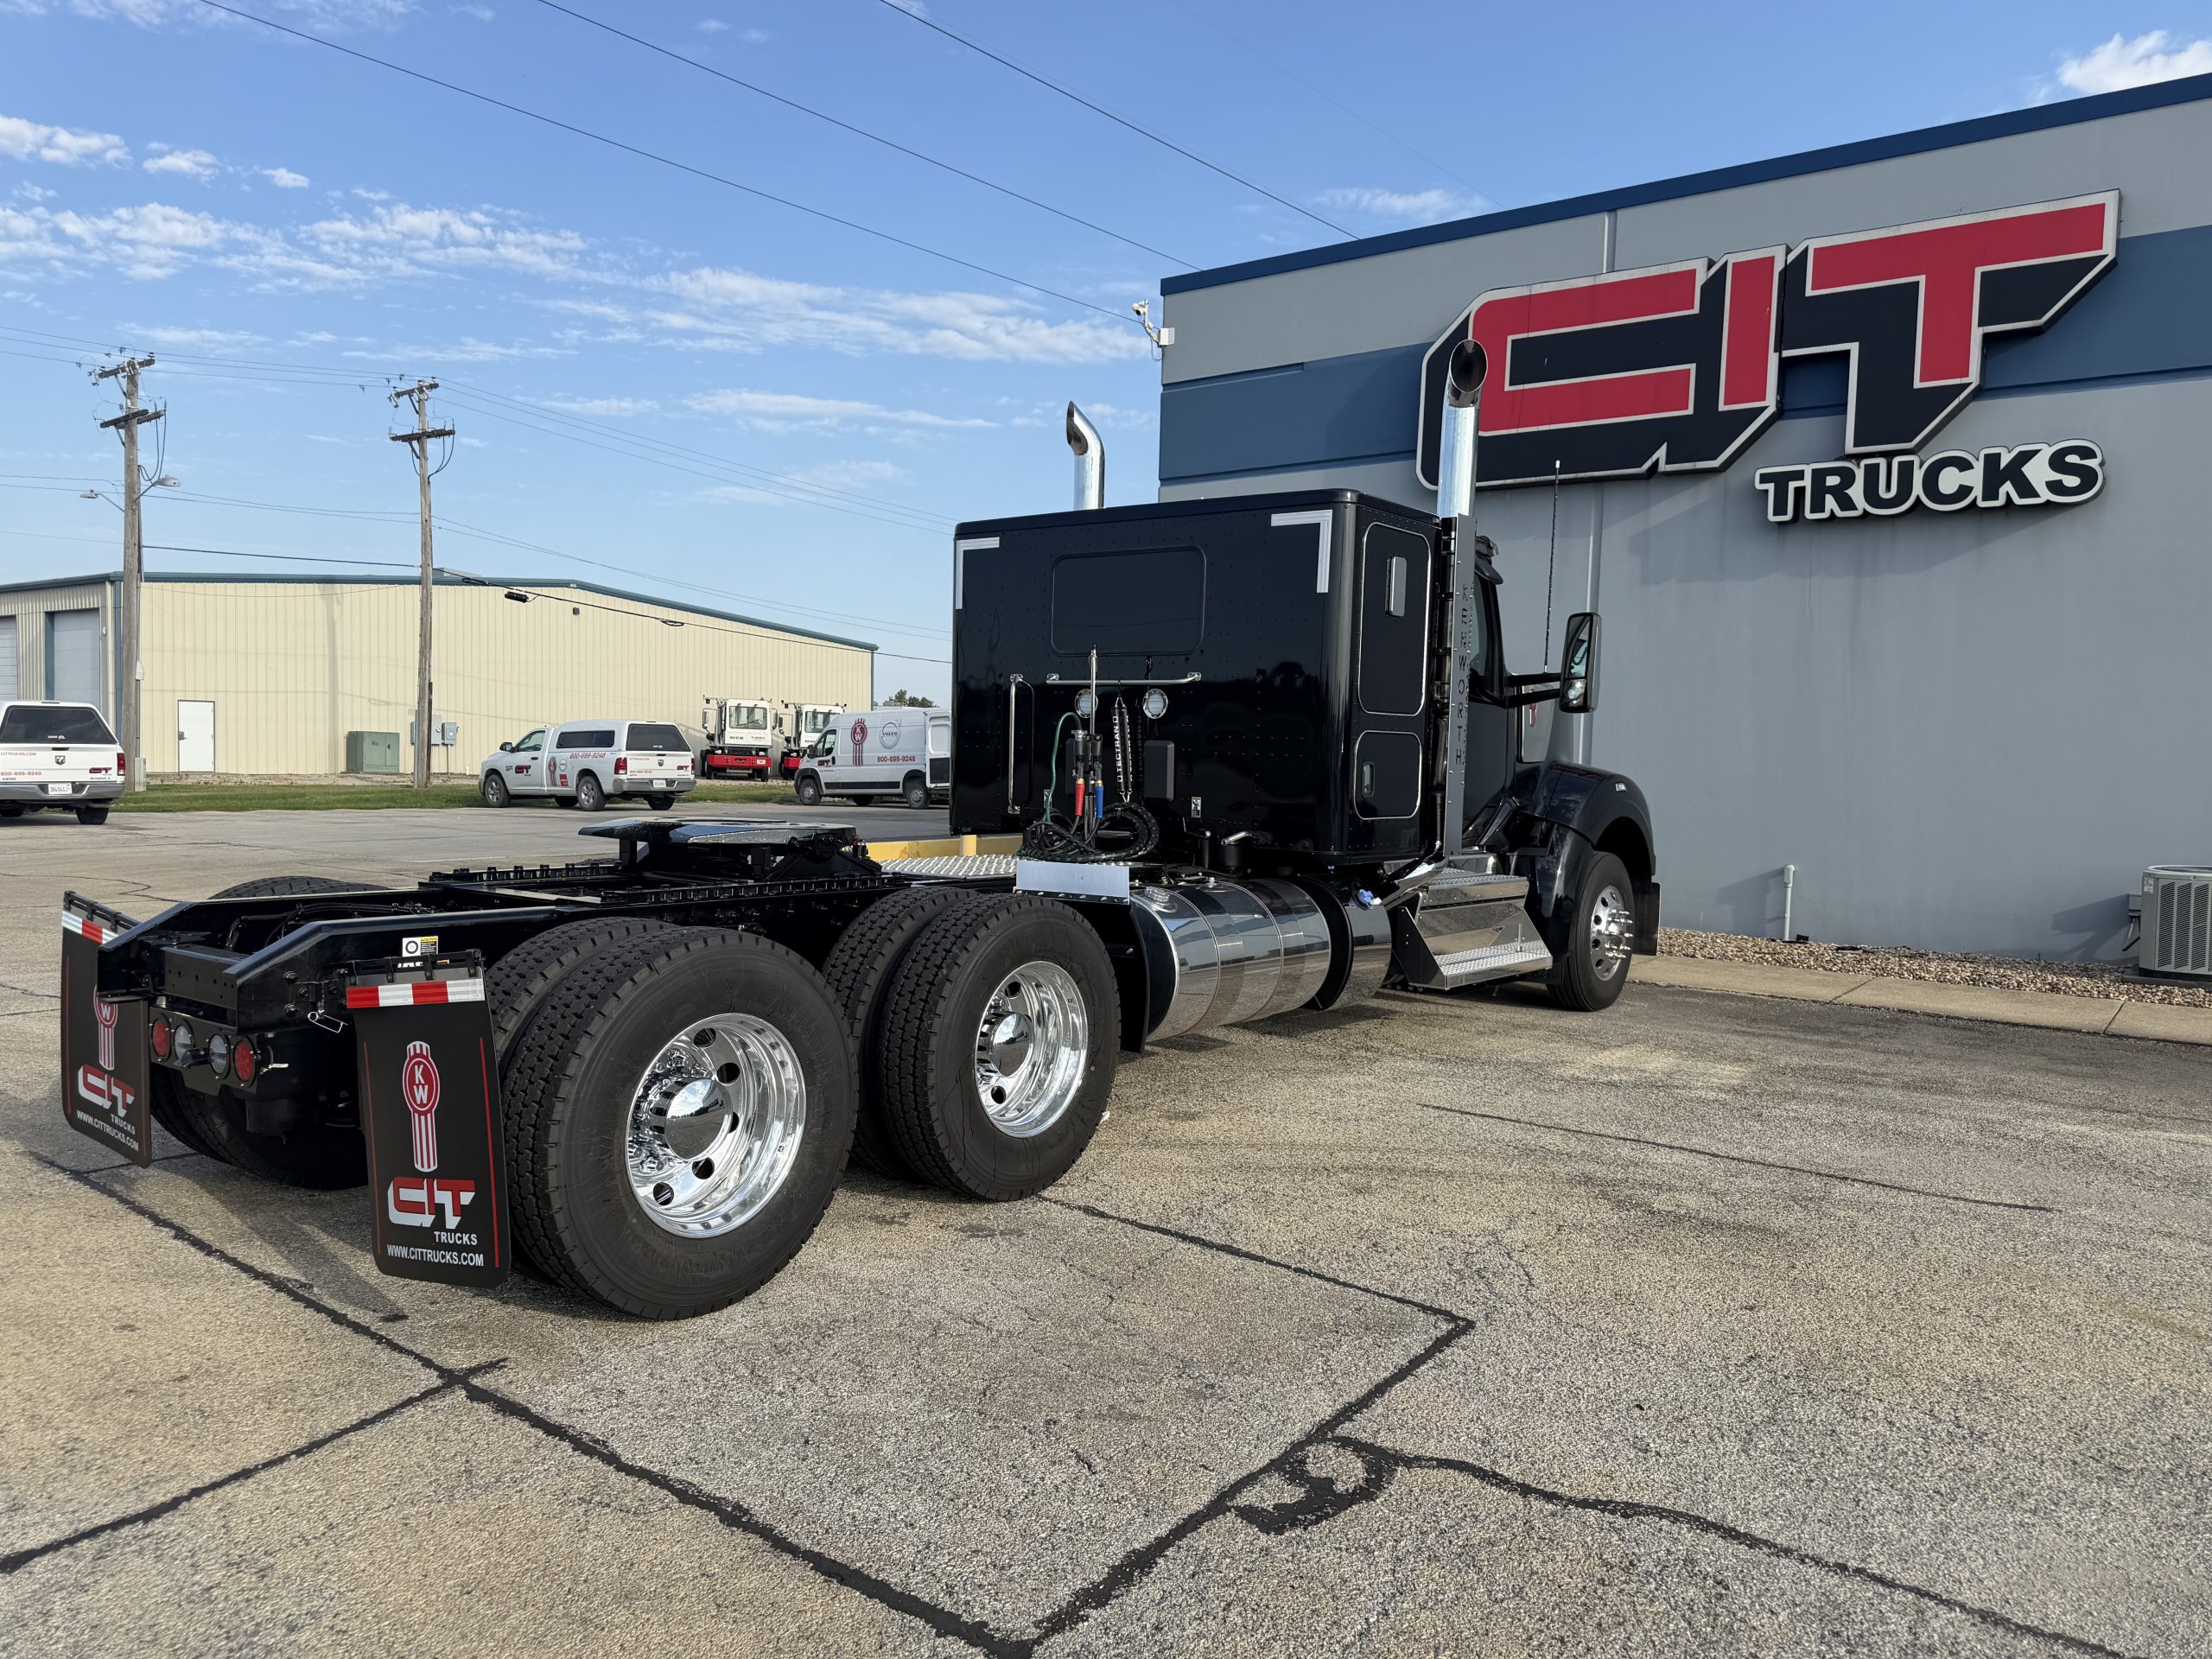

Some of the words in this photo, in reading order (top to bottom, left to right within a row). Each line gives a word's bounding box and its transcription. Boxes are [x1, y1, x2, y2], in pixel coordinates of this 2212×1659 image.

[1416, 189, 2120, 489] CIT
[1755, 440, 2106, 522] TRUCKS
[1455, 583, 1469, 766] KENWORTH
[1114, 726, 1122, 773] TECTRAN
[78, 1064, 136, 1117] CIT
[76, 1109, 139, 1152] WWW.CITTRUCKS.COM
[110, 1113, 136, 1135] TRUCKS
[387, 1176, 475, 1230] CIT
[386, 1243, 484, 1268] WWW.CITTRUCKS.COM
[434, 1230, 478, 1245] TRUCKS
